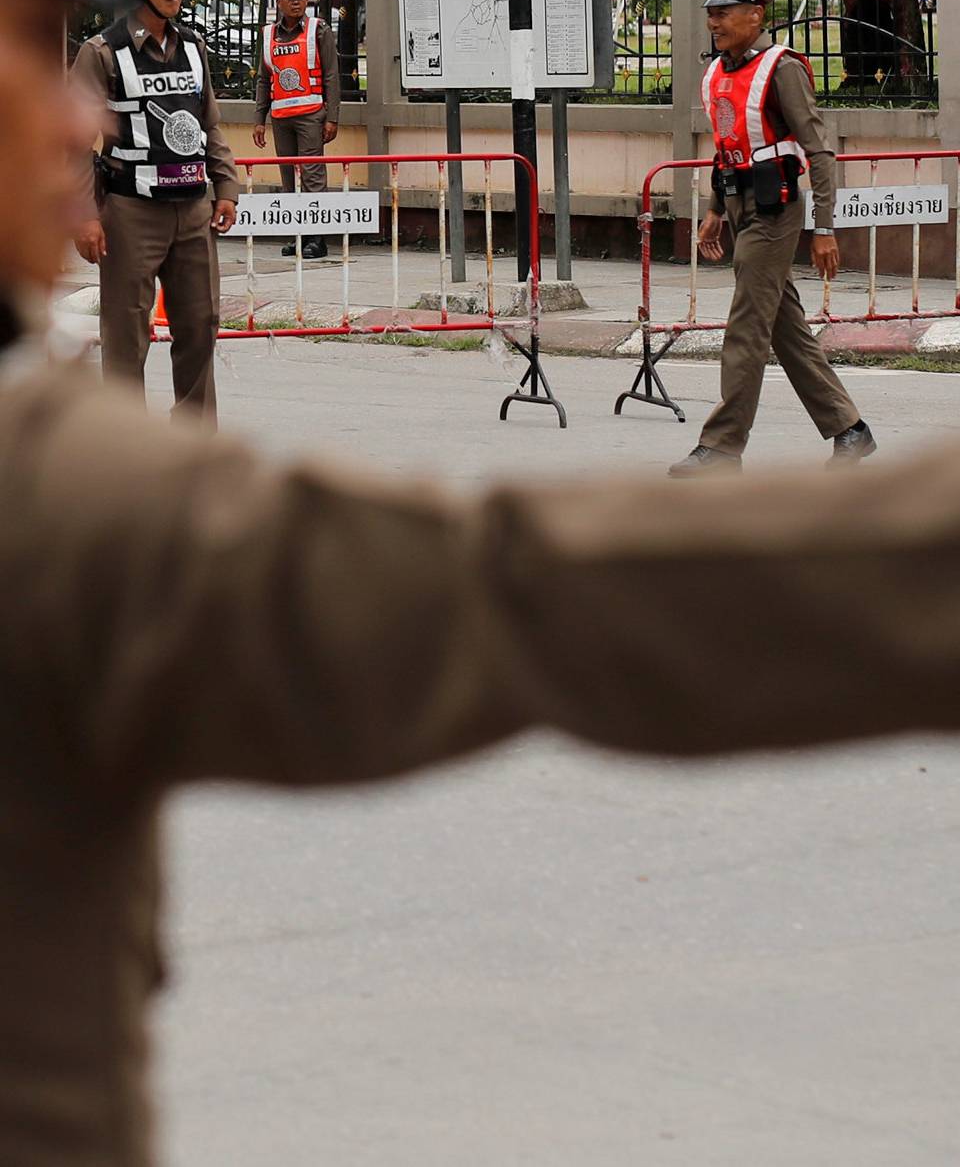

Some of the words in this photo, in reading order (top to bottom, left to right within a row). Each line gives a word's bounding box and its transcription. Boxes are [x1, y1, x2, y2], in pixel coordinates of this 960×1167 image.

[181, 164, 198, 174] SCB
[262, 199, 372, 226] เมืองเชียงราย
[843, 193, 943, 218] เมืองเชียงราย
